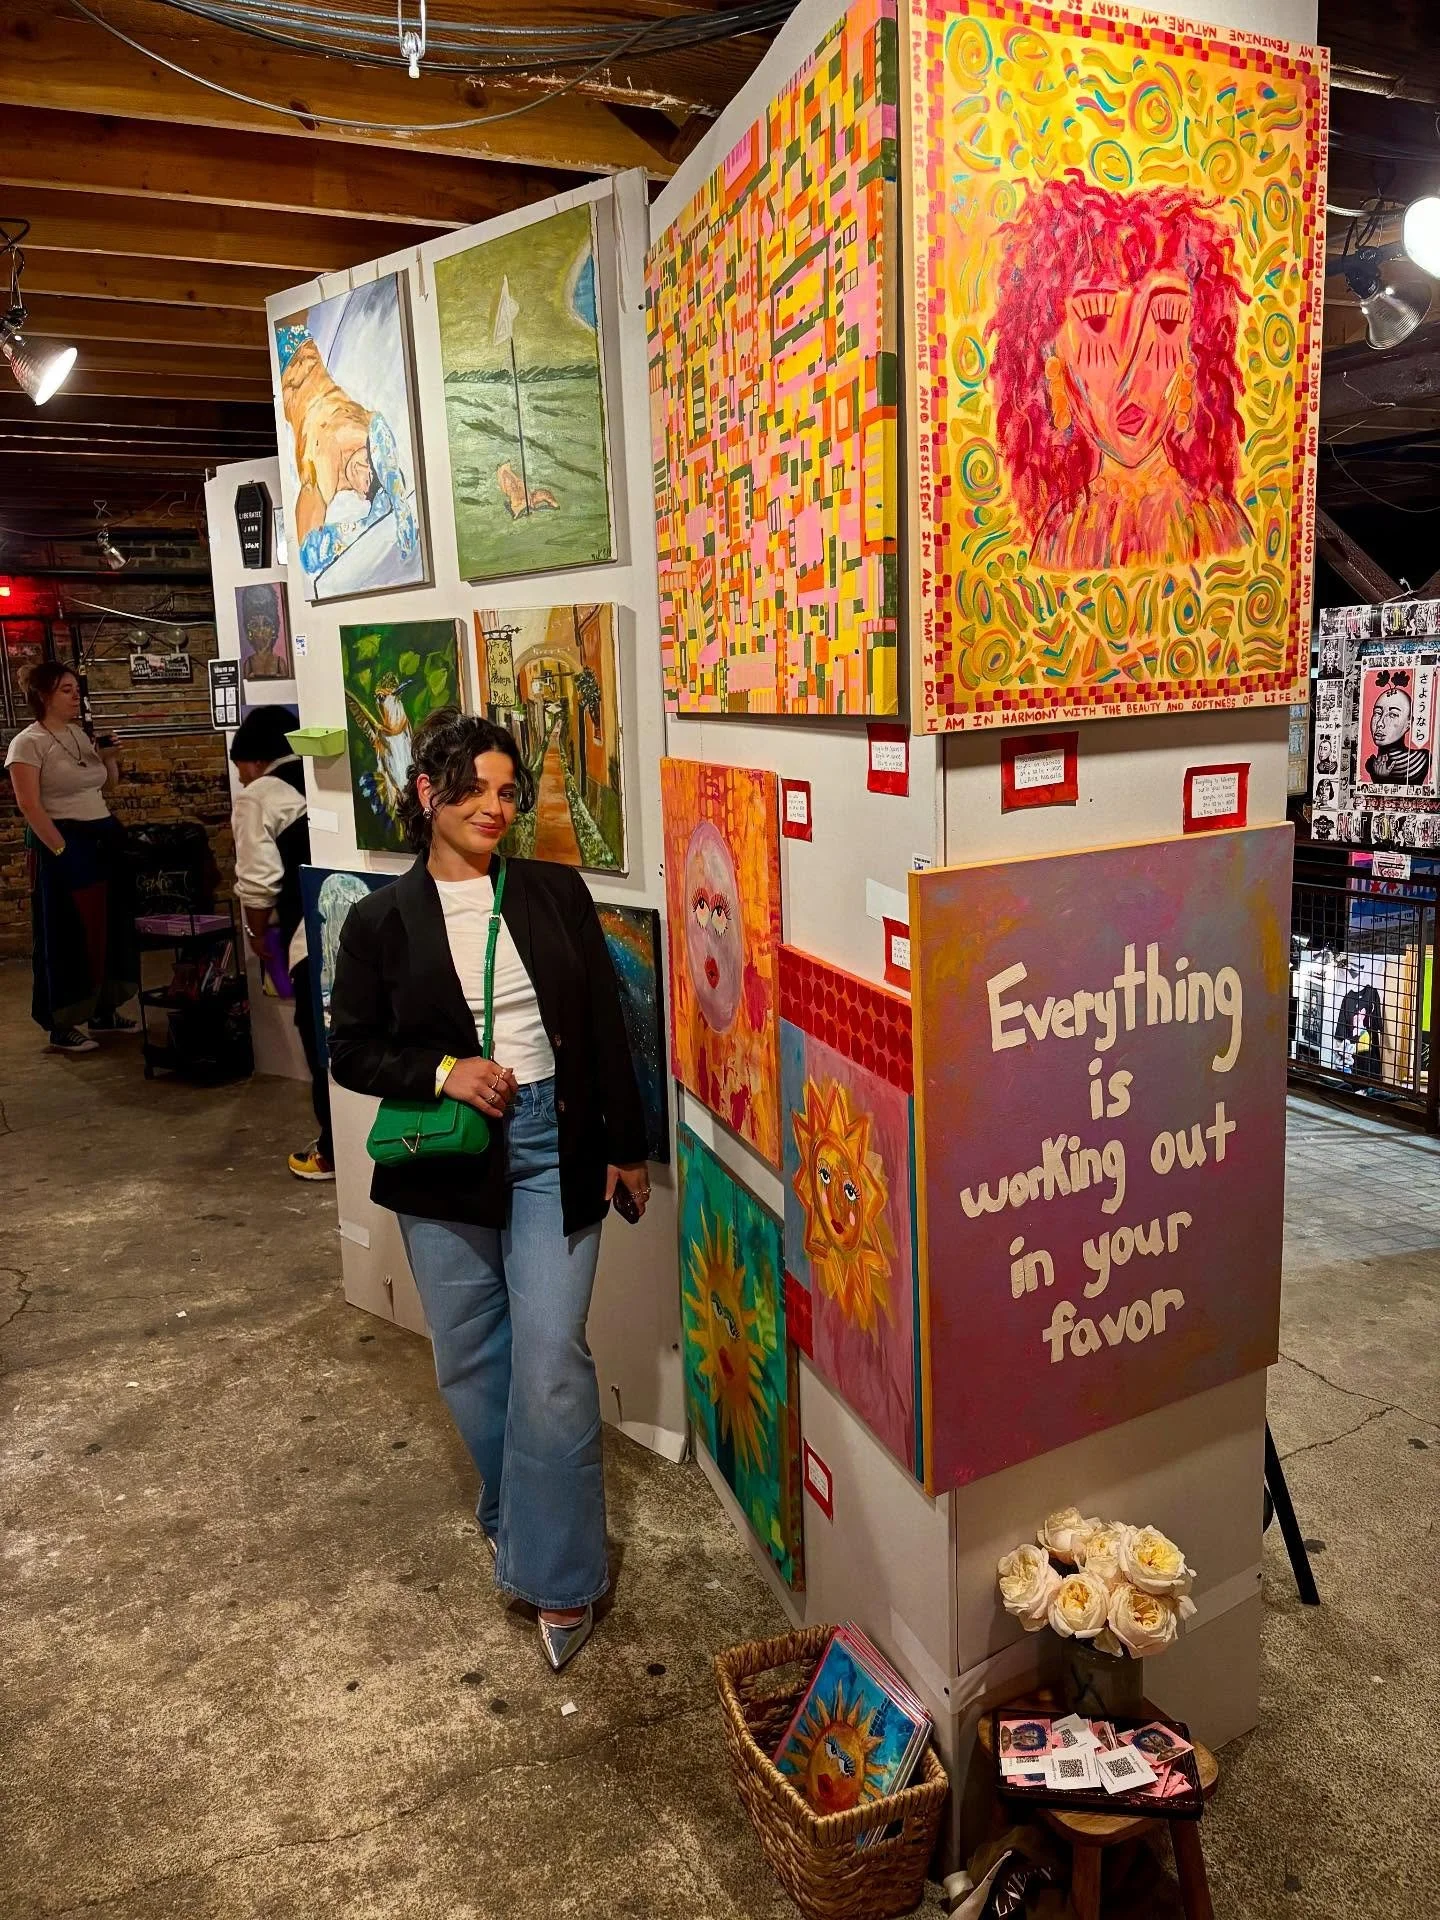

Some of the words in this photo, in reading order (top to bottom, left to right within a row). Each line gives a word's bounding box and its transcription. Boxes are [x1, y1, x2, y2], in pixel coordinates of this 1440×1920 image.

[1091, 2, 1129, 20] HEART
[1141, 11, 1159, 26] MY
[1229, 29, 1289, 53] FEMININE
[1299, 46, 1314, 58] MY
[1320, 48, 1329, 73] IN
[1319, 83, 1329, 173] STRENGTH
[1316, 185, 1326, 219] AND
[1315, 231, 1325, 279] PEACE
[1312, 287, 1322, 327] FIND
[919, 386, 930, 424] AND
[1307, 426, 1317, 457] AND
[920, 433, 932, 522] RESILIENT
[1304, 467, 1315, 564] COMPASSION
[922, 531, 932, 558] IN
[1303, 574, 1312, 605] LOVE
[923, 607, 933, 644] THAT
[1300, 618, 1310, 678] RADIATE
[927, 718, 938, 732] I
[945, 717, 965, 730] AM
[973, 715, 994, 727] IN
[1002, 708, 1059, 724] HARMONY
[1063, 706, 1097, 718] WITH
[1102, 704, 1122, 715] THE
[1127, 702, 1161, 714] BEAUTY
[1166, 702, 1184, 712] AND
[1191, 698, 1236, 710] SOFTNESS
[1243, 694, 1255, 706] OF
[1416, 673, 1428, 741] さようなら
[986, 942, 1243, 1073] Everything
[1088, 1057, 1134, 1120] is
[1150, 1102, 1236, 1175] out
[1009, 1236, 1055, 1299] in
[1083, 1211, 1192, 1299] your
[1042, 1288, 1185, 1364] favor
